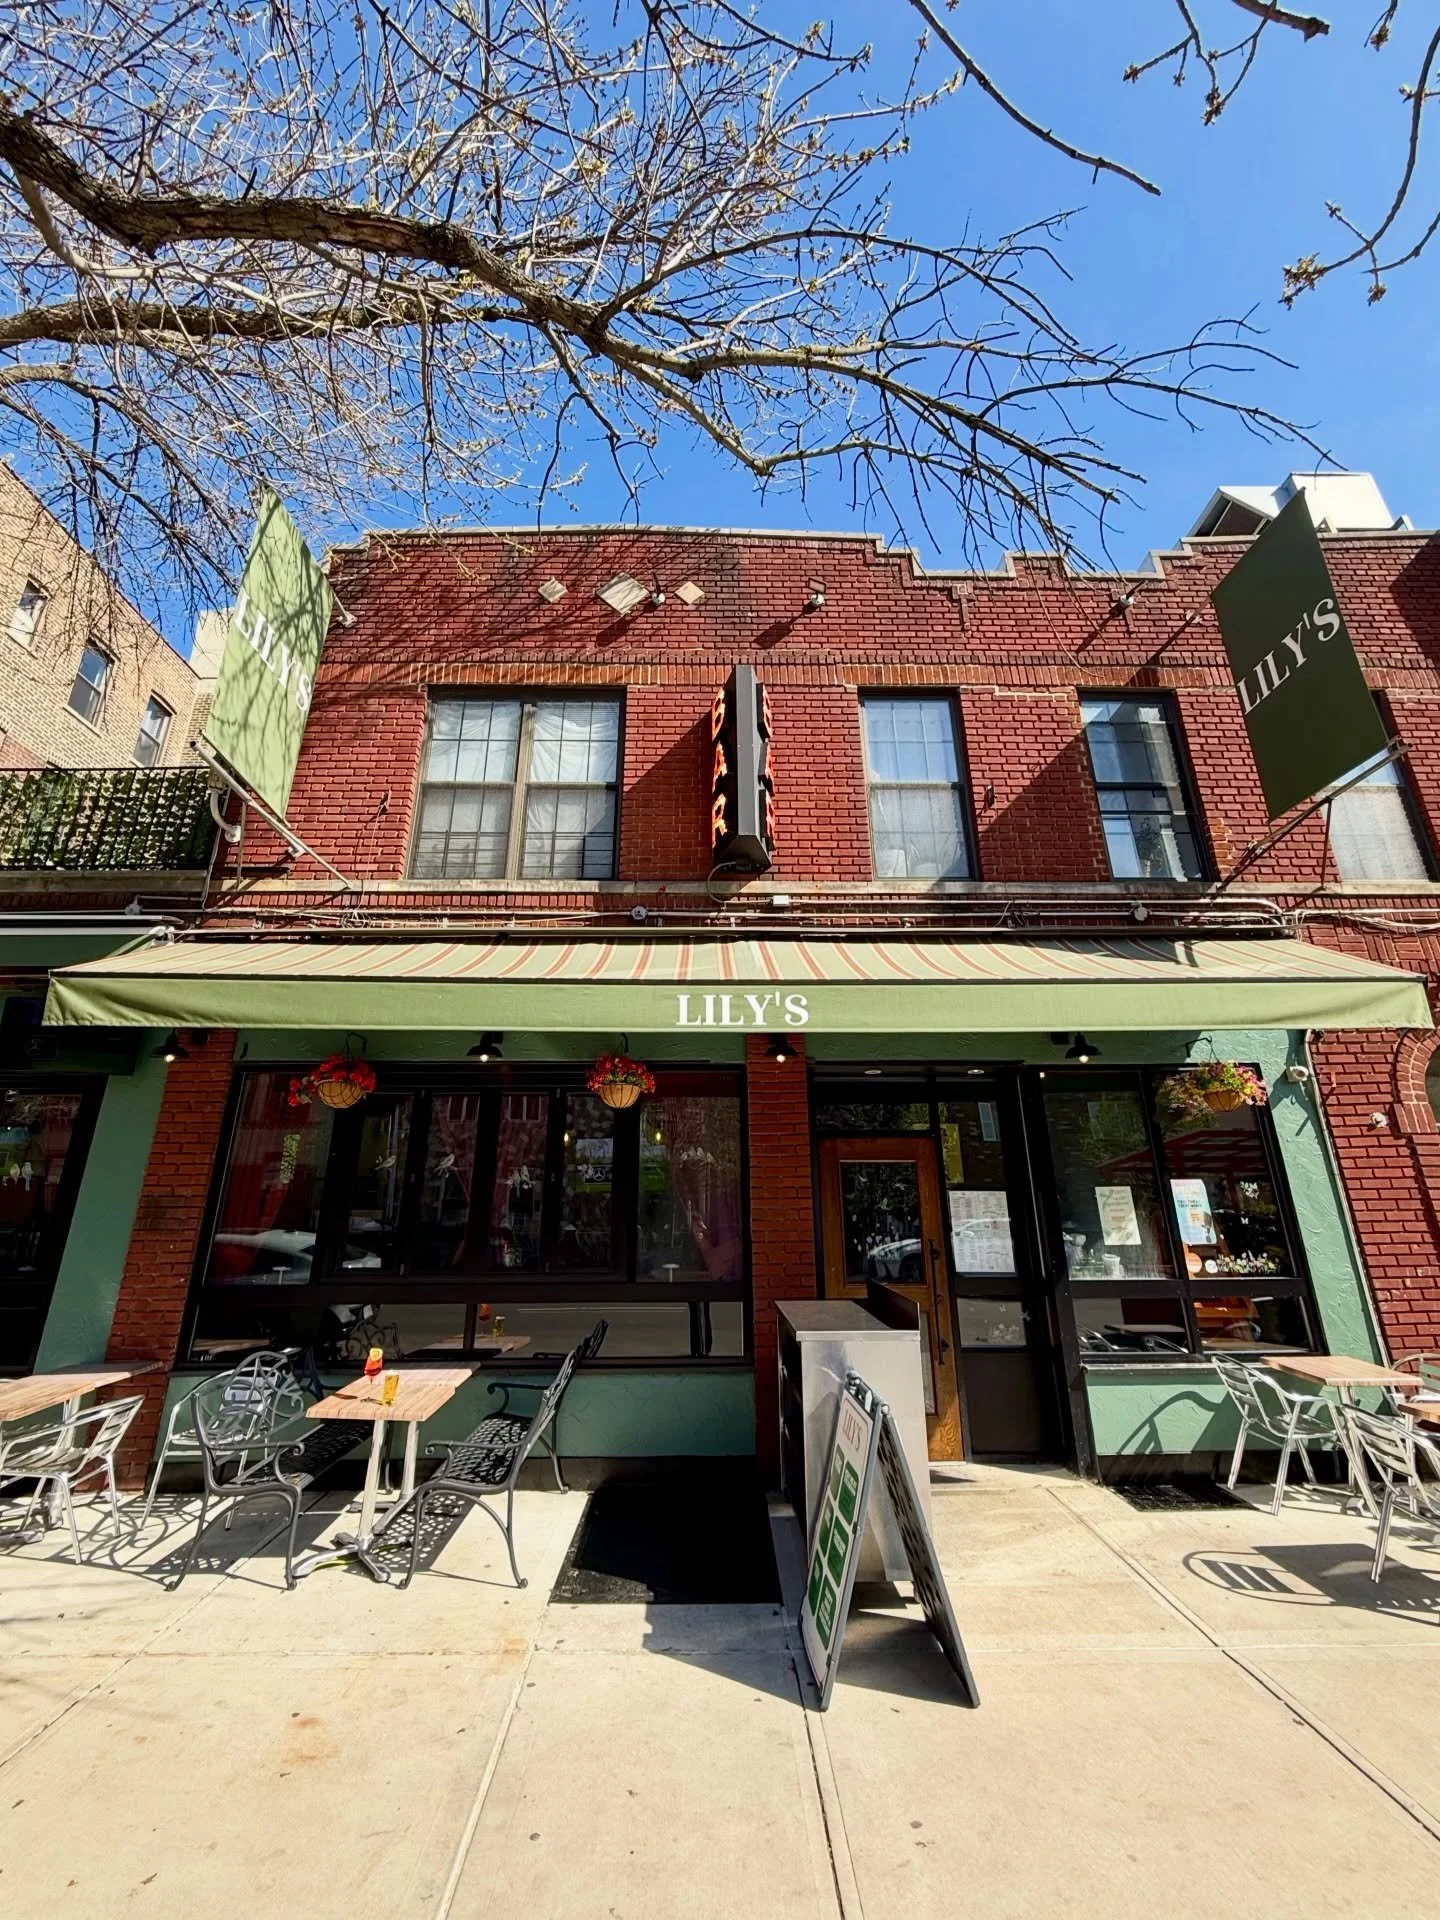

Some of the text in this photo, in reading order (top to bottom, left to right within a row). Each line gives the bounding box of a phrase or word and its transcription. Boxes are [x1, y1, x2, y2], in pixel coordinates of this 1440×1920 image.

[235, 586, 311, 712] LILY'S
[1237, 598, 1340, 715] LILY'S
[676, 991, 809, 1026] LILY'S
[842, 1410, 863, 1452] LILY'S
